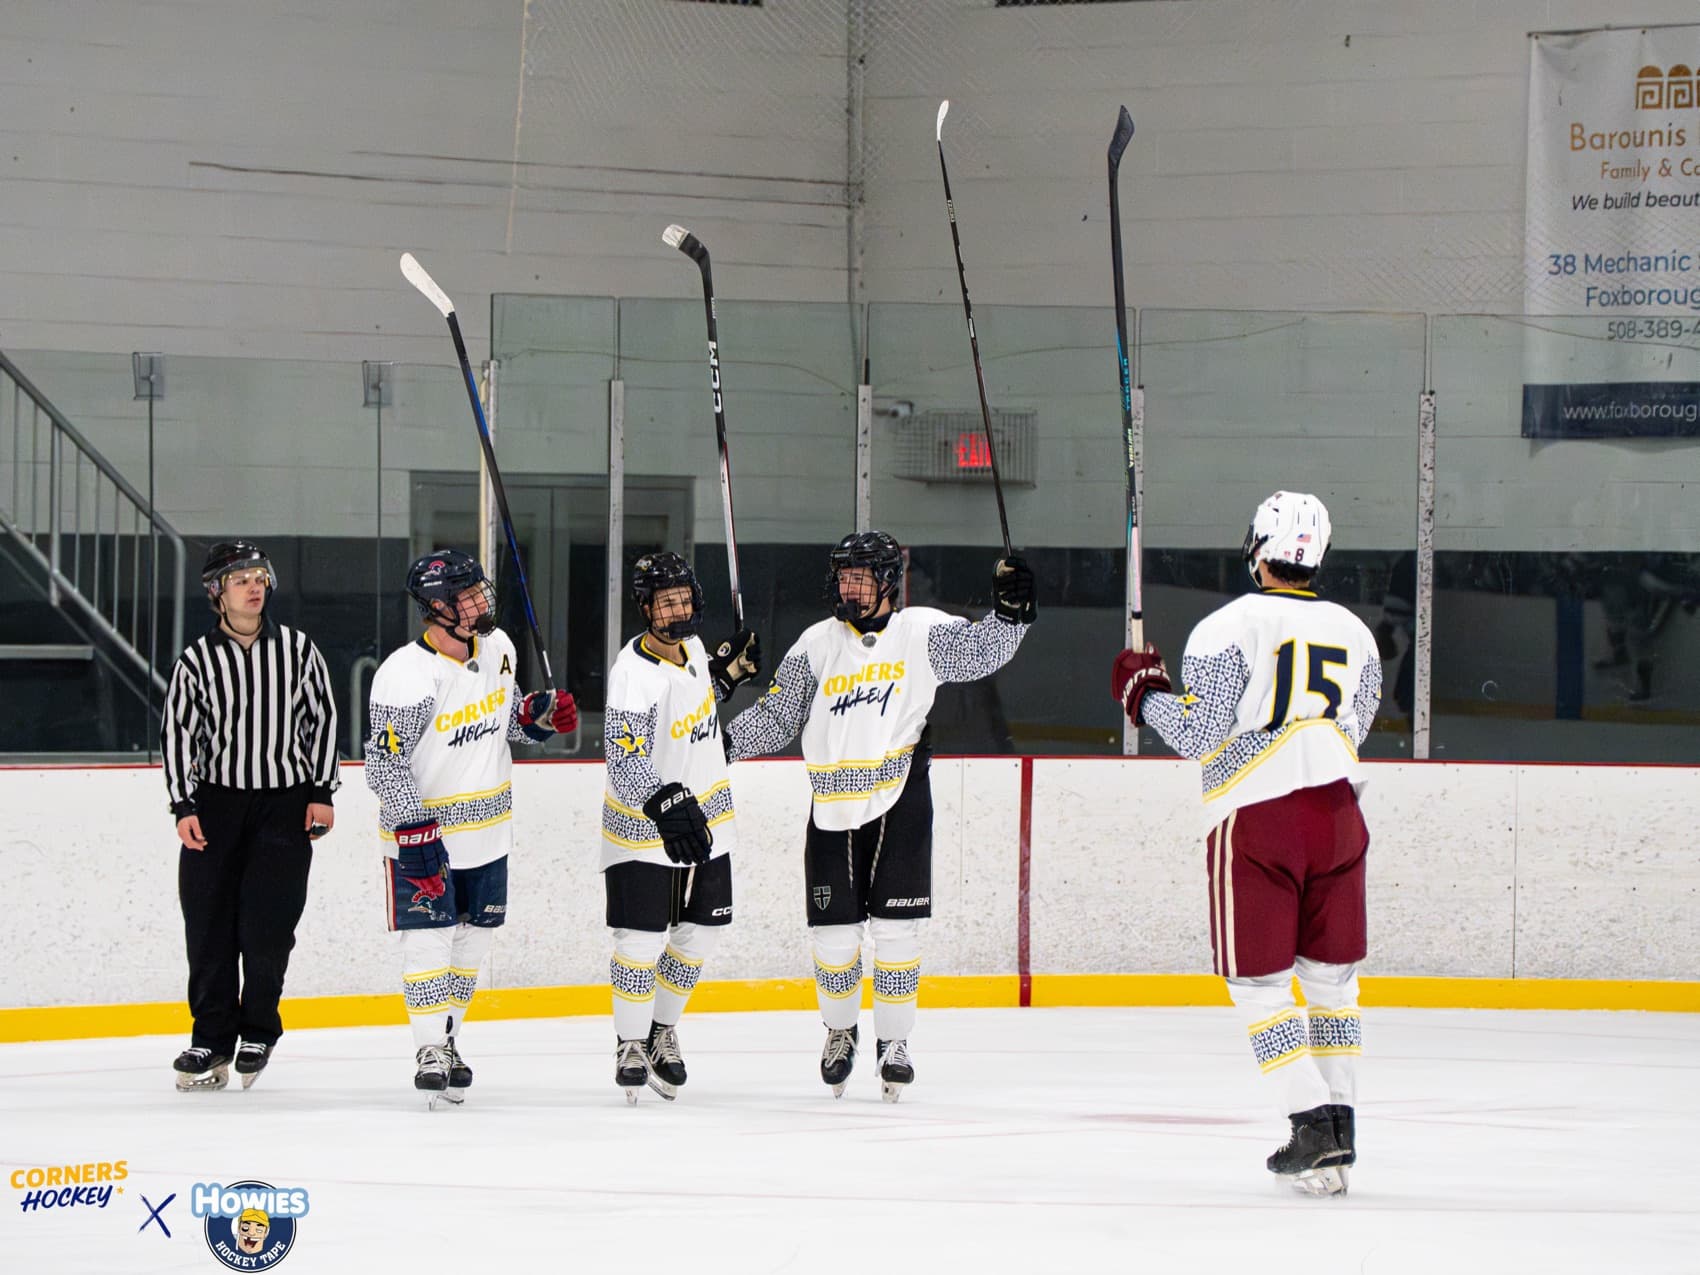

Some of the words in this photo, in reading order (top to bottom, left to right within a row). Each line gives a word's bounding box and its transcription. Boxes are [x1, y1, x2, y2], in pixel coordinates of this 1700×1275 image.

[1569, 122, 1686, 151] Barounis
[1600, 159, 1651, 182] Family
[1658, 157, 1673, 178] &
[1572, 194, 1599, 211] We
[1603, 191, 1642, 210] build
[1548, 253, 1577, 275] 38
[1584, 250, 1691, 274] Mechanic
[500, 653, 513, 676] A
[1262, 636, 1349, 734] 15
